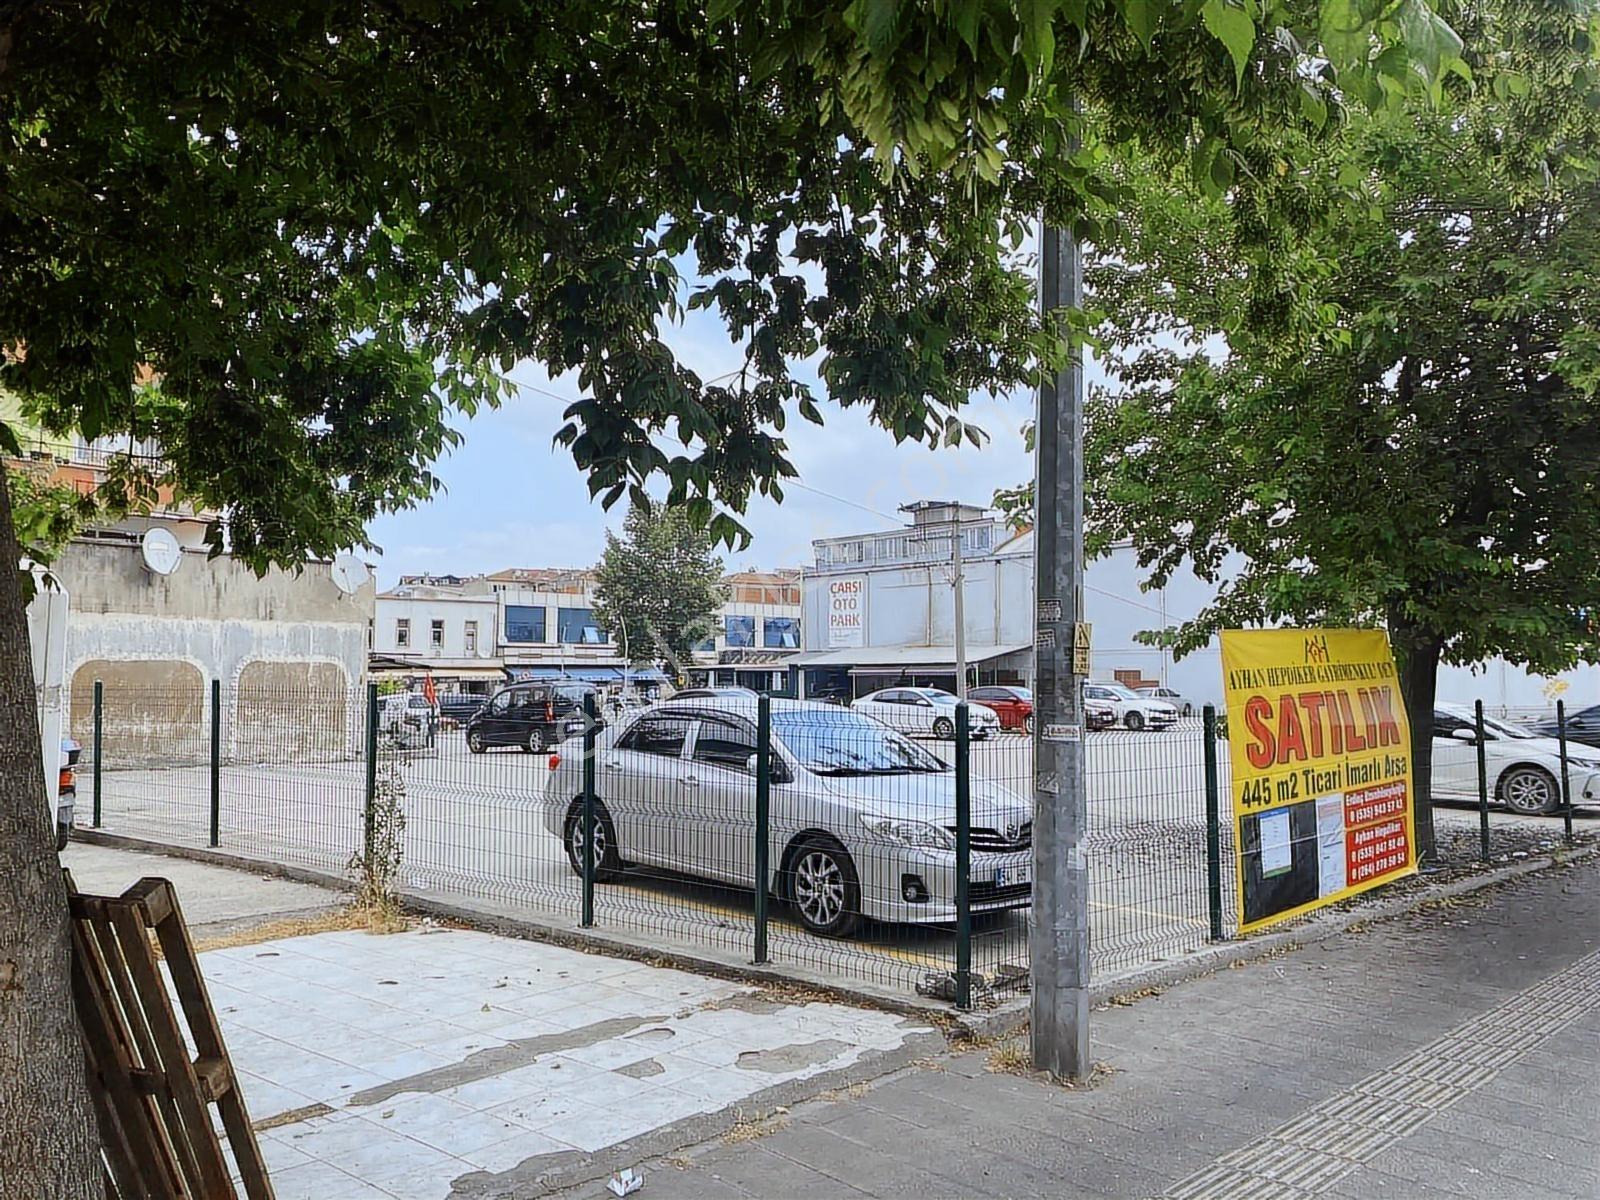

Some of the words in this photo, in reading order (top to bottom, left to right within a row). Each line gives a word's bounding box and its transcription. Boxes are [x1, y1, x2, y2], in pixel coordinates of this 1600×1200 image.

[833, 598, 858, 611] OTO
[830, 614, 861, 627] PARK
[1229, 667, 1266, 690] AYHAN
[1245, 686, 1401, 770] SATILIK
[1242, 777, 1272, 808] 445
[1277, 773, 1299, 802] m2
[1303, 765, 1342, 796] Ticari
[1346, 756, 1381, 787] İmarlı
[1384, 754, 1408, 779] Arsa
